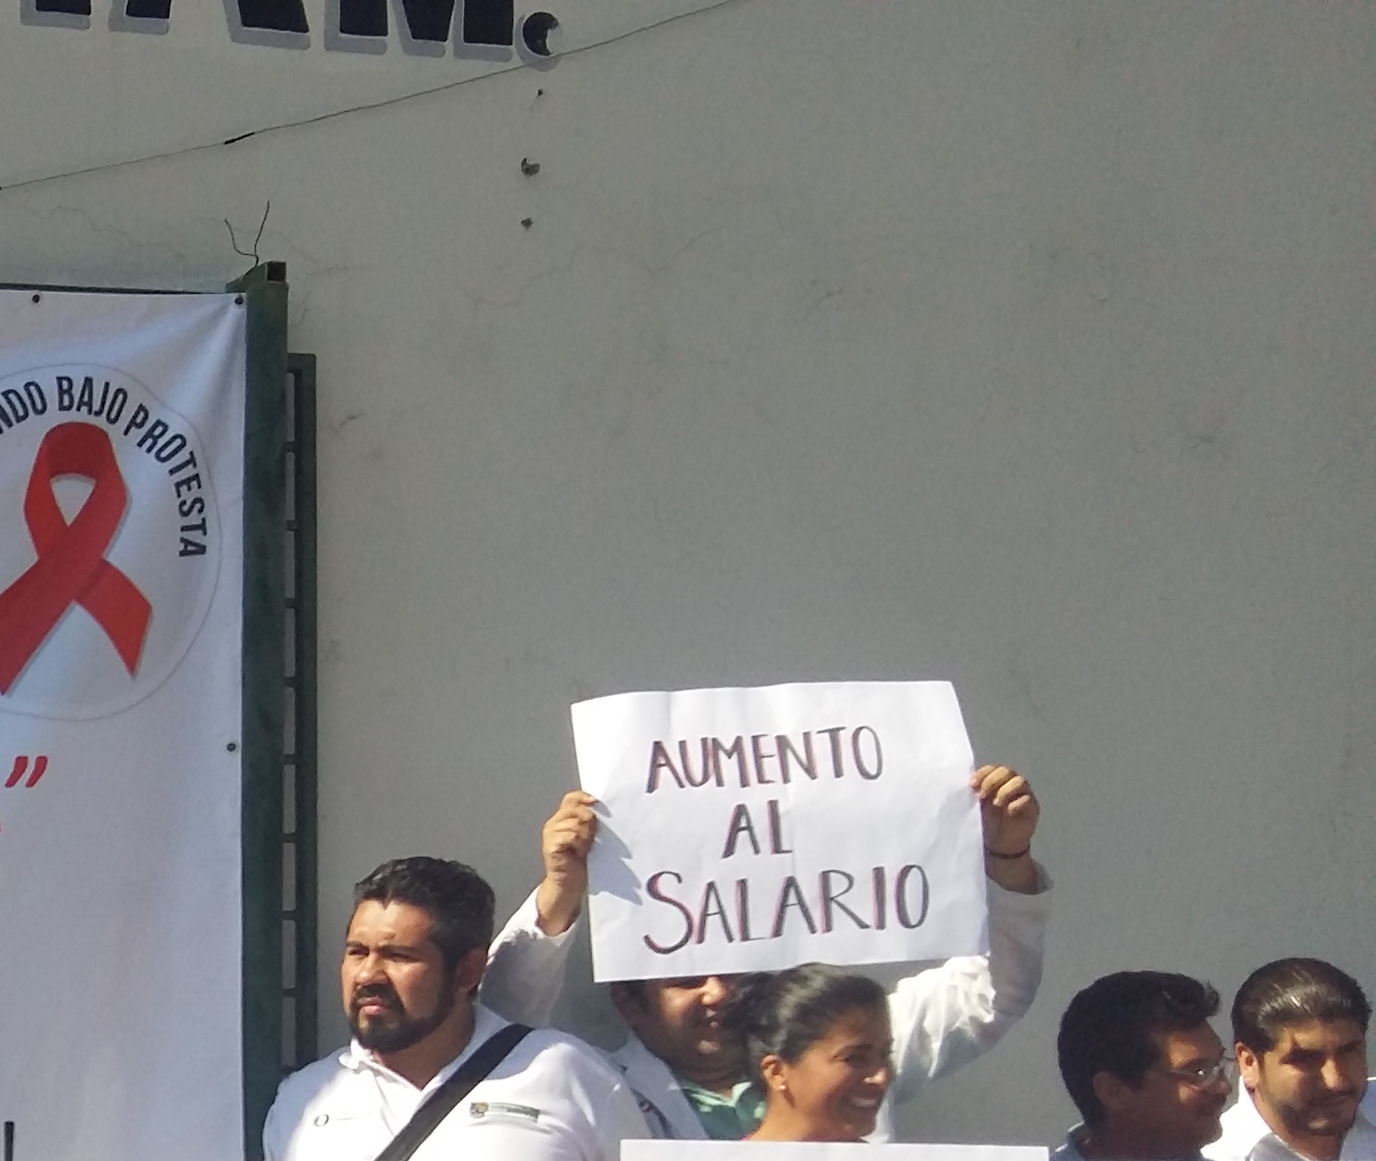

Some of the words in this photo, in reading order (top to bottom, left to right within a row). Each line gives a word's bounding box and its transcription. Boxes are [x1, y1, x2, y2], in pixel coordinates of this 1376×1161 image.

[55, 376, 128, 425] BAJO
[123, 404, 206, 557] PROTESTA
[646, 725, 883, 793] AUMENTO
[721, 799, 793, 859] AL
[644, 864, 929, 955] SALARIO
